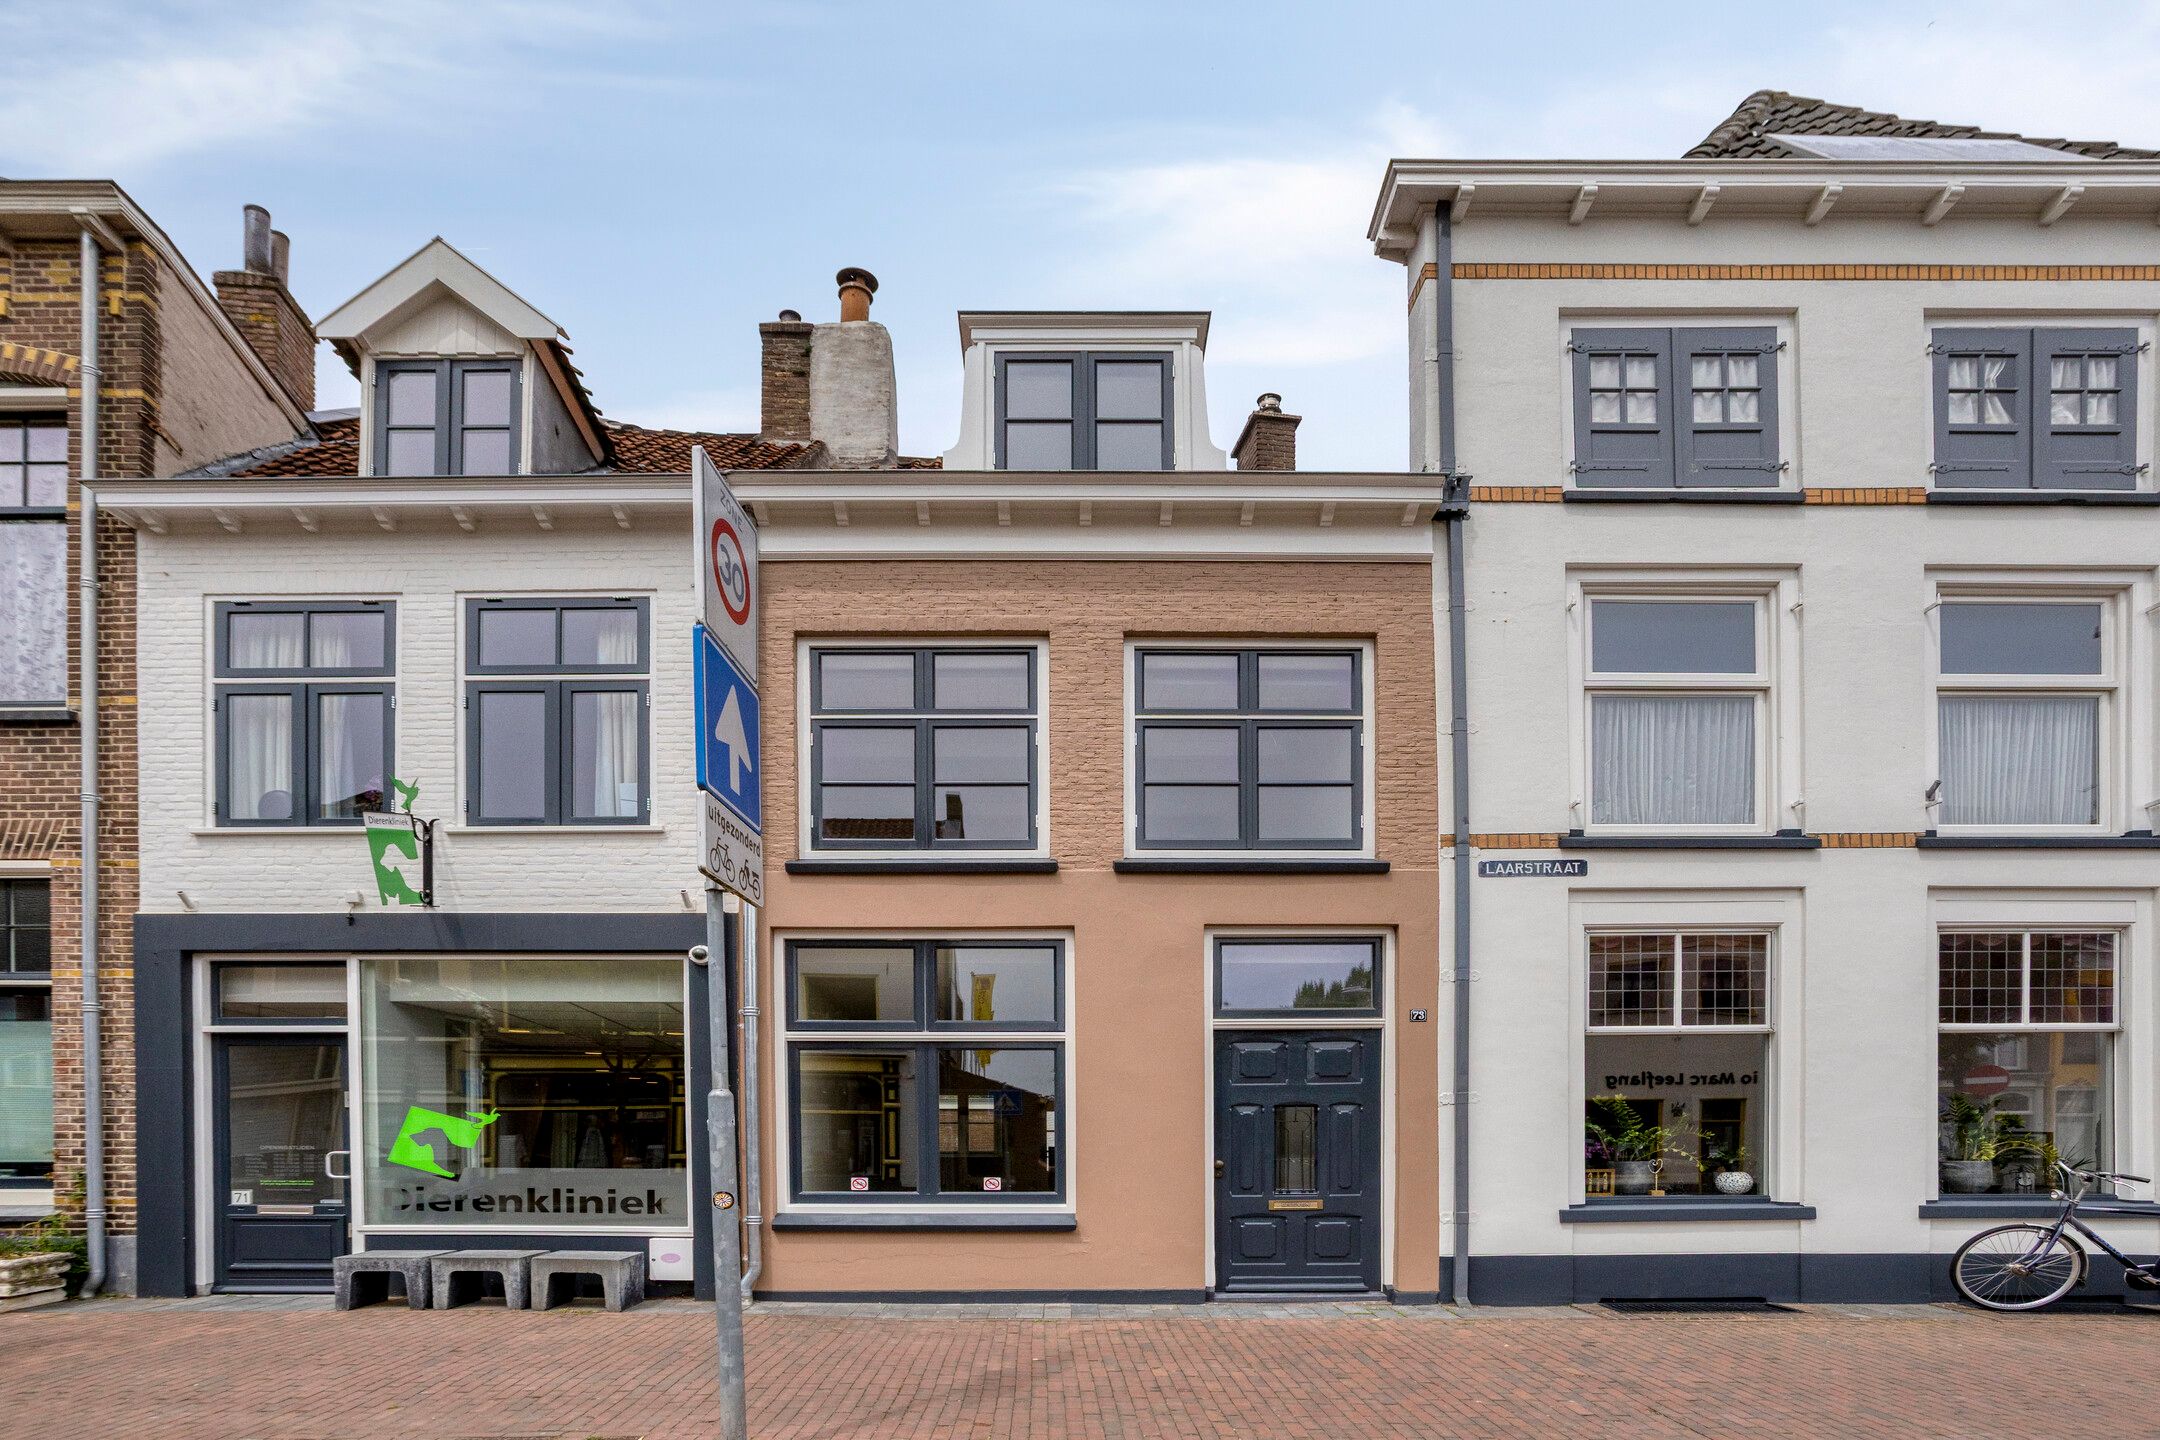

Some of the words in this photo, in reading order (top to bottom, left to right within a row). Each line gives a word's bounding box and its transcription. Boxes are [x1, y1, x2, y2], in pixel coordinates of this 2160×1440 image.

[719, 488, 744, 533] ZONE
[719, 543, 744, 603] 30
[368, 815, 409, 826] Dierenkliniek
[708, 805, 761, 858] uitgezonderd
[1485, 862, 1581, 874] LAARSTRAAT
[1412, 1010, 1425, 1020] 73
[234, 1192, 249, 1203] 71
